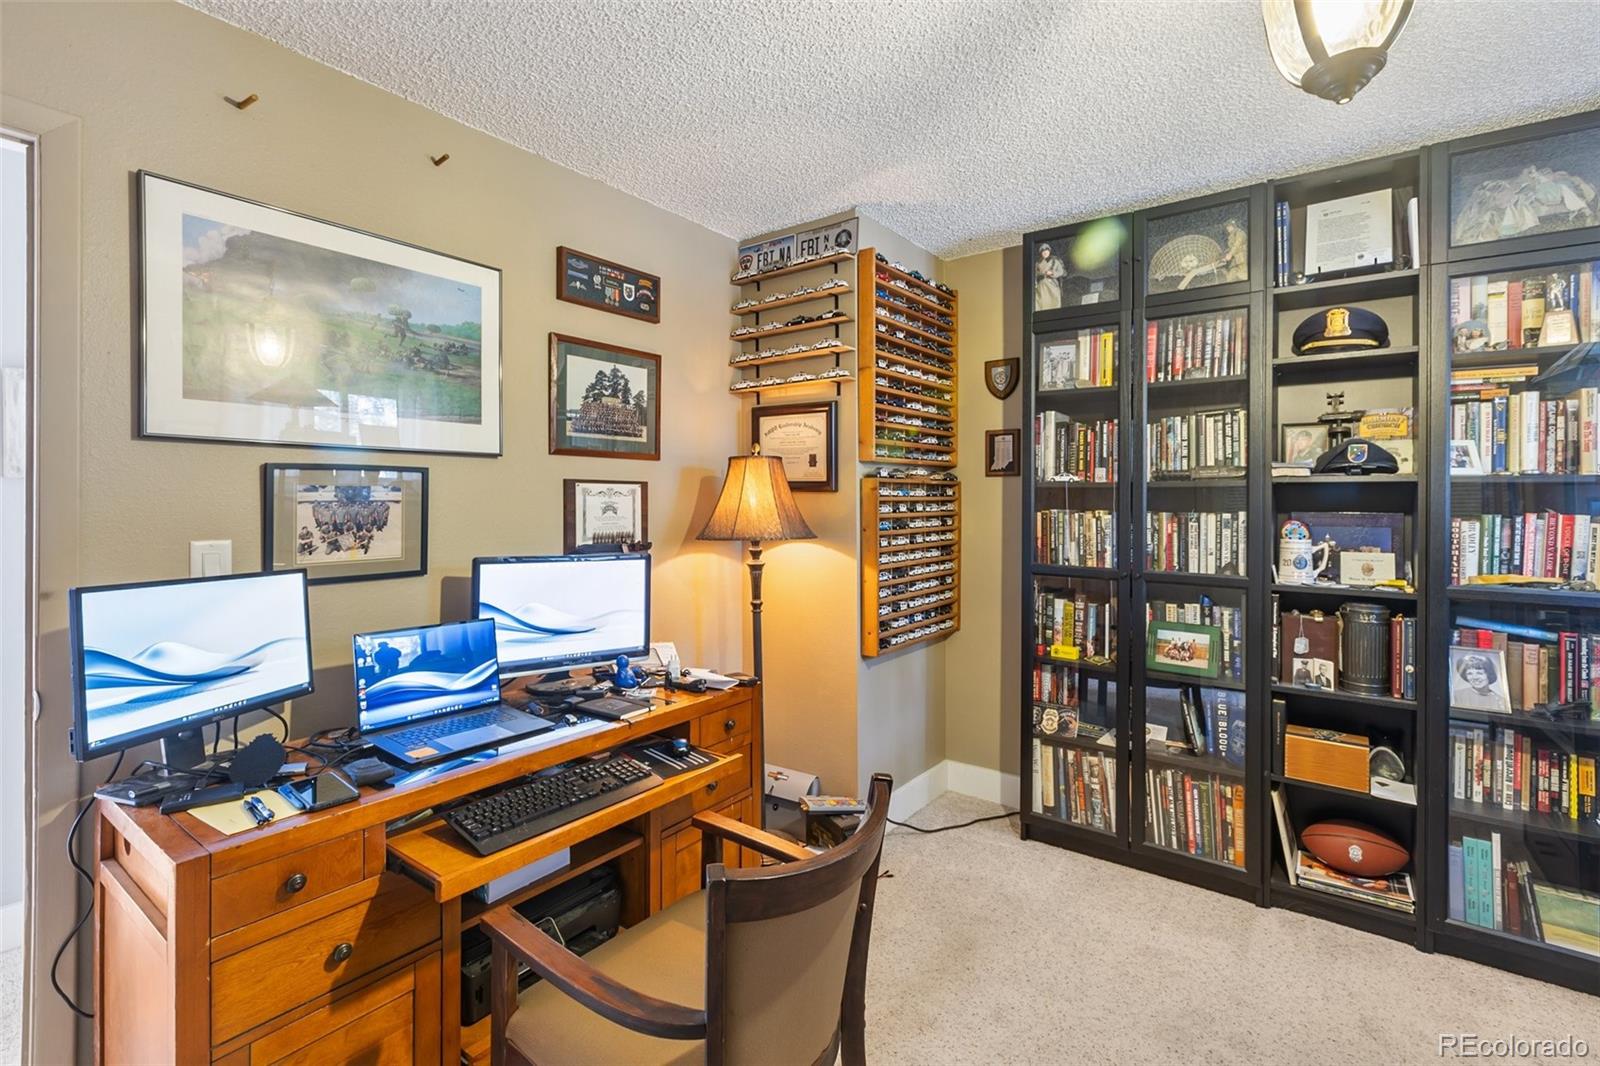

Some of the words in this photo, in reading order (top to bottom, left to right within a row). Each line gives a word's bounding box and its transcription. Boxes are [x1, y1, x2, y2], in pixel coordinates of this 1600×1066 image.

[757, 250, 775, 269] FBI
[780, 246, 792, 264] NA
[801, 237, 820, 257] FBI
[1547, 517, 1556, 546] BEYOND
[1546, 547, 1555, 570] VALOR
[1217, 692, 1227, 716] BLUE
